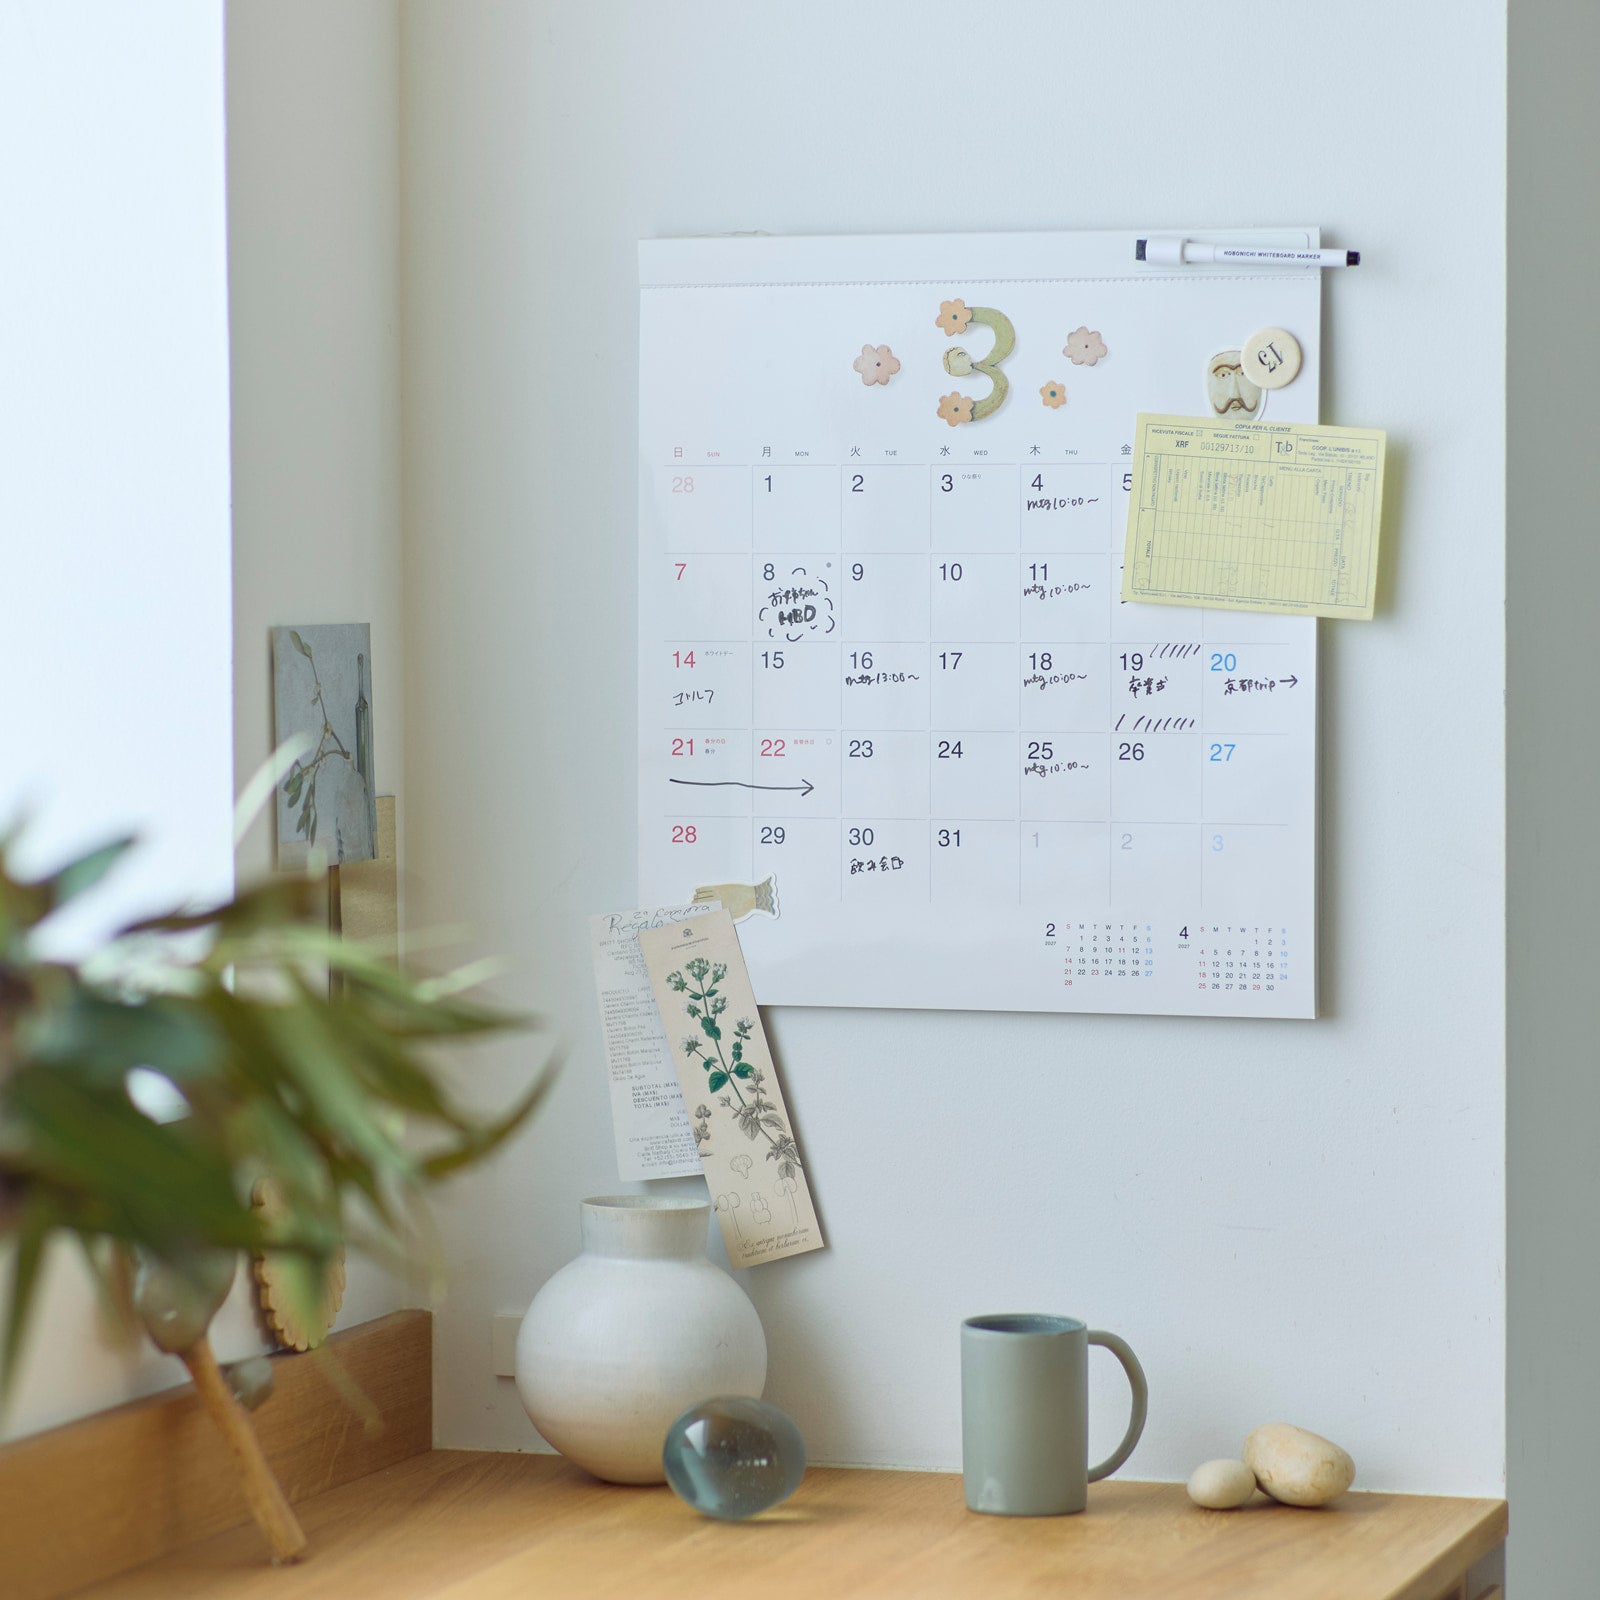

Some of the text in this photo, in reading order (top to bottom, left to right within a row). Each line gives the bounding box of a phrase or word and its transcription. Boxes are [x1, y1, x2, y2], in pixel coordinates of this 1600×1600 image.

[1223, 250, 1256, 258] HOBONICHI
[1258, 252, 1296, 260] WHITEBOARD
[1268, 425, 1292, 433] CLIENTE
[674, 447, 682, 457] 日
[762, 447, 770, 457] 月
[851, 446, 860, 456] 火
[940, 446, 950, 456] 水
[1030, 445, 1040, 455] 木
[1121, 444, 1131, 455] 金
[1175, 440, 1189, 448] XRF
[672, 475, 953, 493] 28 1 2 3
[1032, 474, 1132, 492] 4 5
[675, 563, 1047, 581] 7 8 9 10 11
[673, 651, 695, 668] 14
[762, 652, 1236, 671] 15 16 17 18 19 20
[672, 739, 693, 755] 21
[761, 739, 785, 756] 22
[849, 740, 1235, 761] 23 24 25 26 27
[672, 826, 1223, 851] 28 29 30 31 1 2 3
[1046, 923, 1055, 936] 2
[1180, 926, 1188, 939] 4
